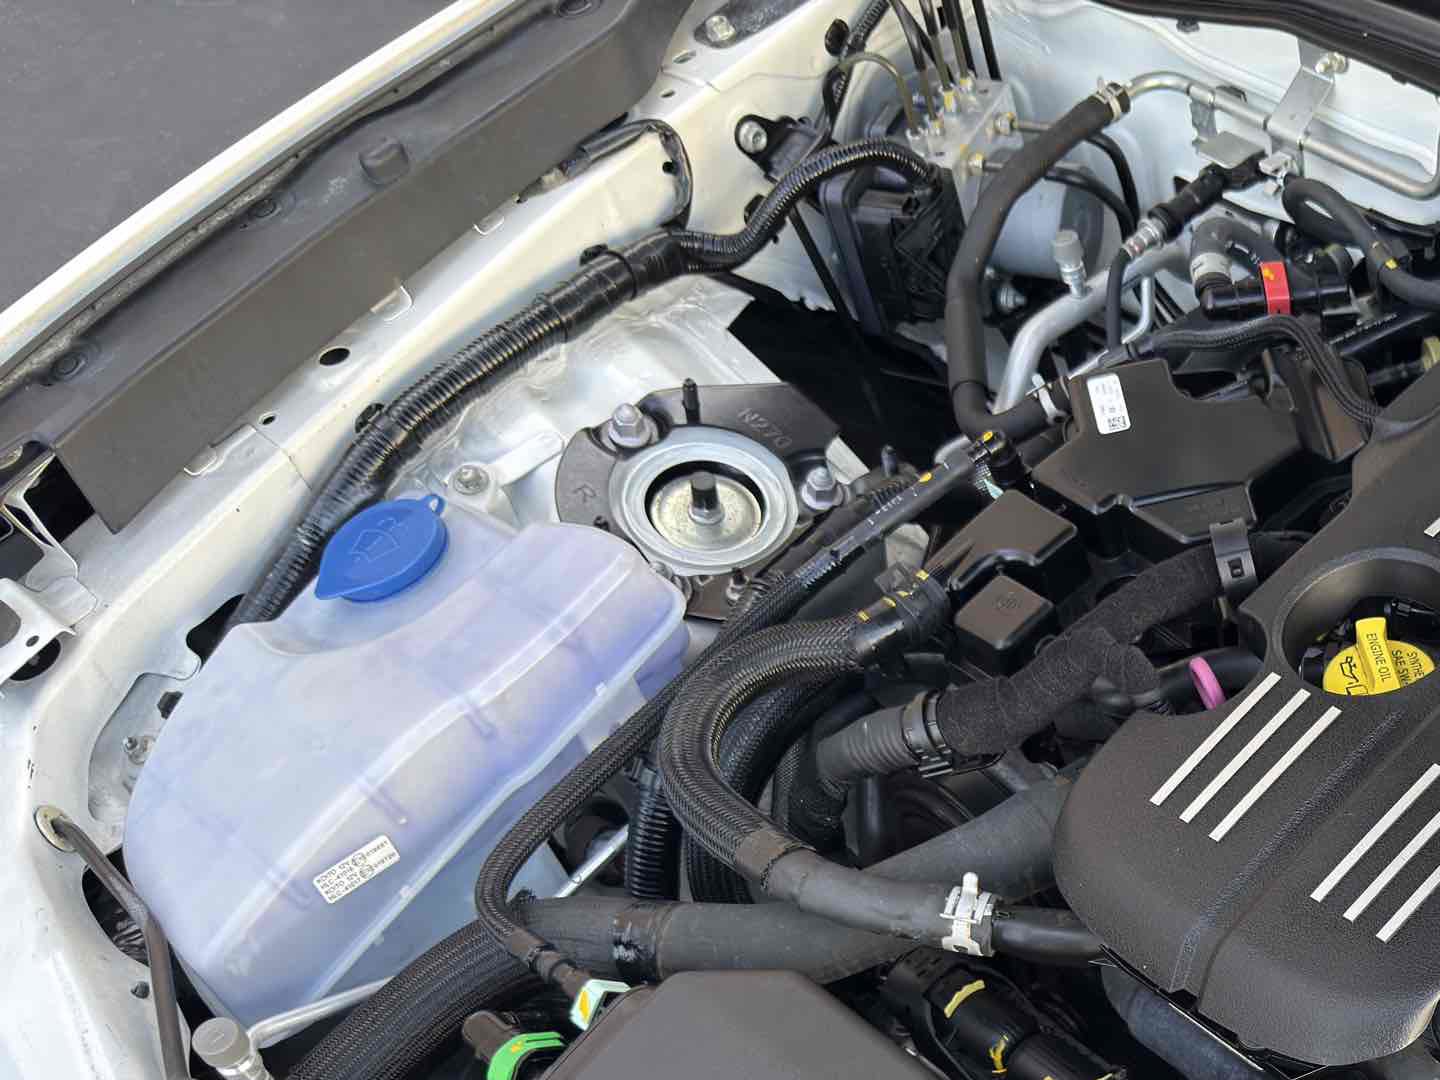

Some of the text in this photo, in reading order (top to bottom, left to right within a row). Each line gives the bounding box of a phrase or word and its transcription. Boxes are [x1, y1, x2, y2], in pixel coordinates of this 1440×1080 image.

[1364, 631, 1392, 683] ENGINE OIL
[1390, 647, 1406, 667] SAE
[1406, 650, 1426, 681] SYNTHE
